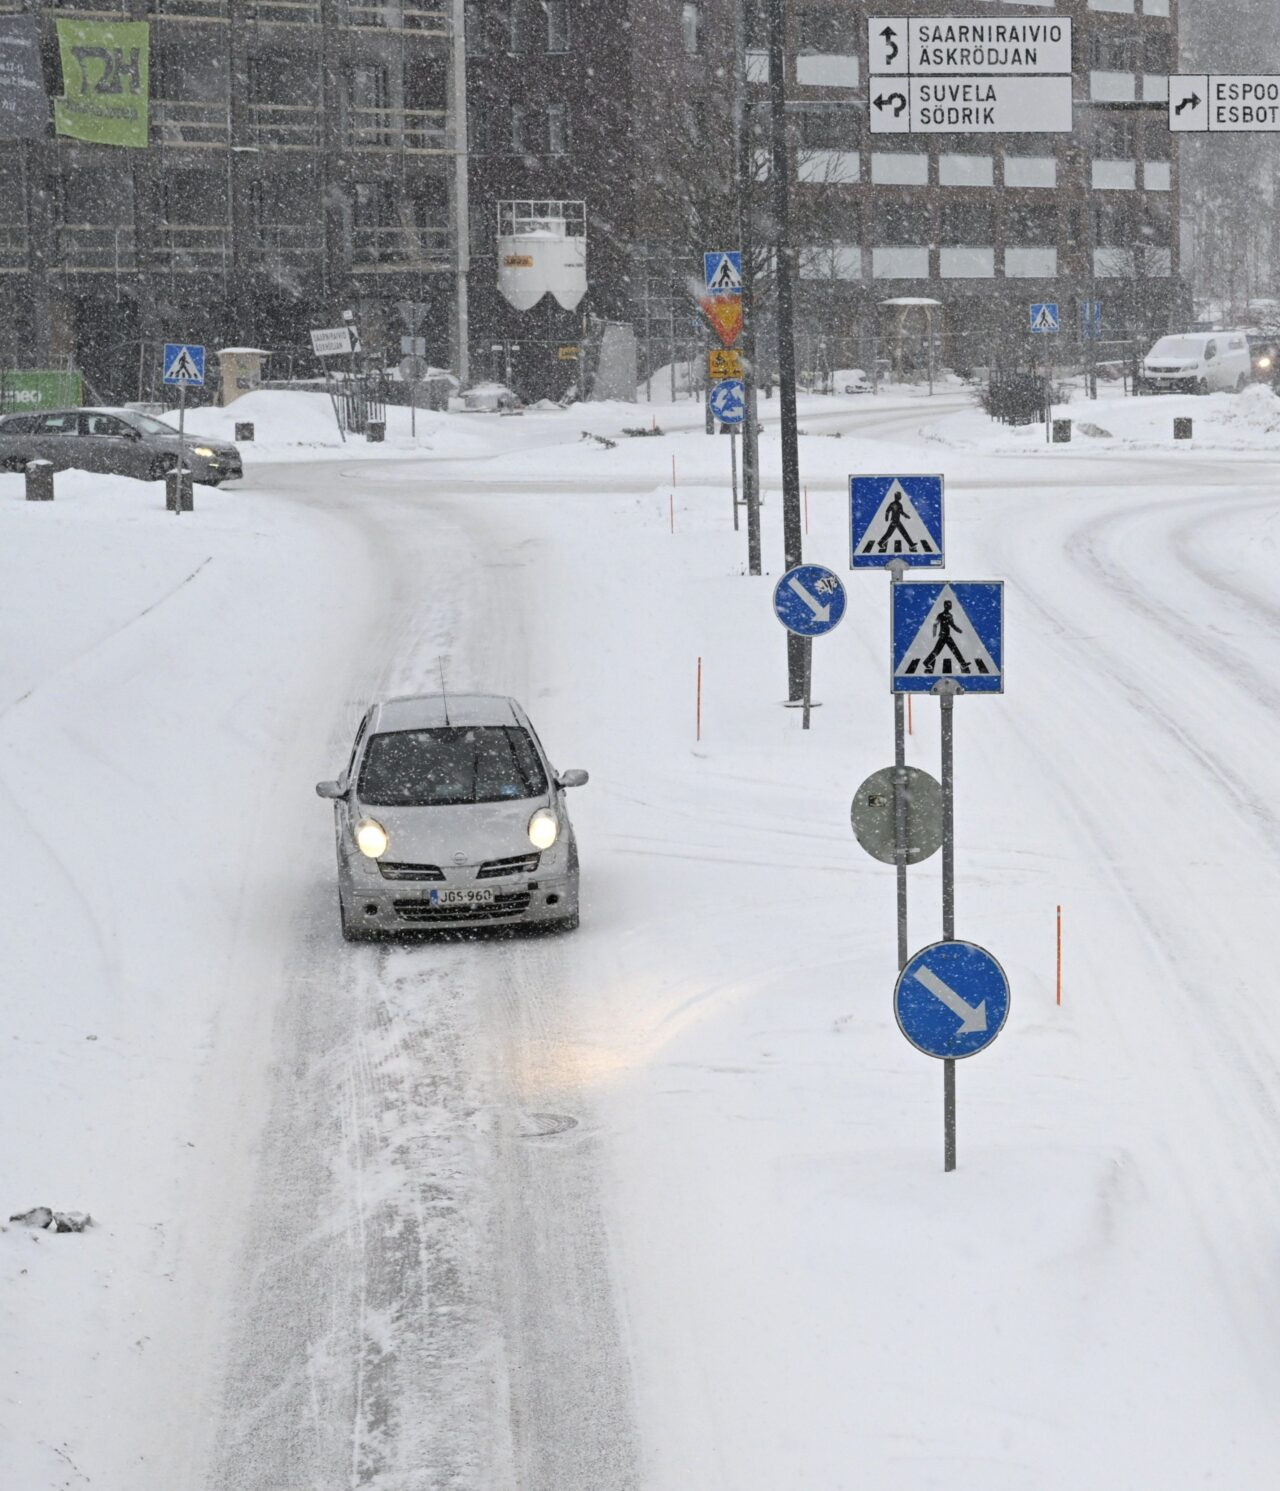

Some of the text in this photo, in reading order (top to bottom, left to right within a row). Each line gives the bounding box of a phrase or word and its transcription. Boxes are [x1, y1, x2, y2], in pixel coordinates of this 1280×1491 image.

[919, 25, 1062, 42] SAARNIRAIVIO
[919, 45, 1037, 66] ÄSKRÖDJAN
[920, 85, 997, 102] SUVELA
[920, 104, 995, 124] SÖDRIK
[440, 889, 492, 903] JGS-960
